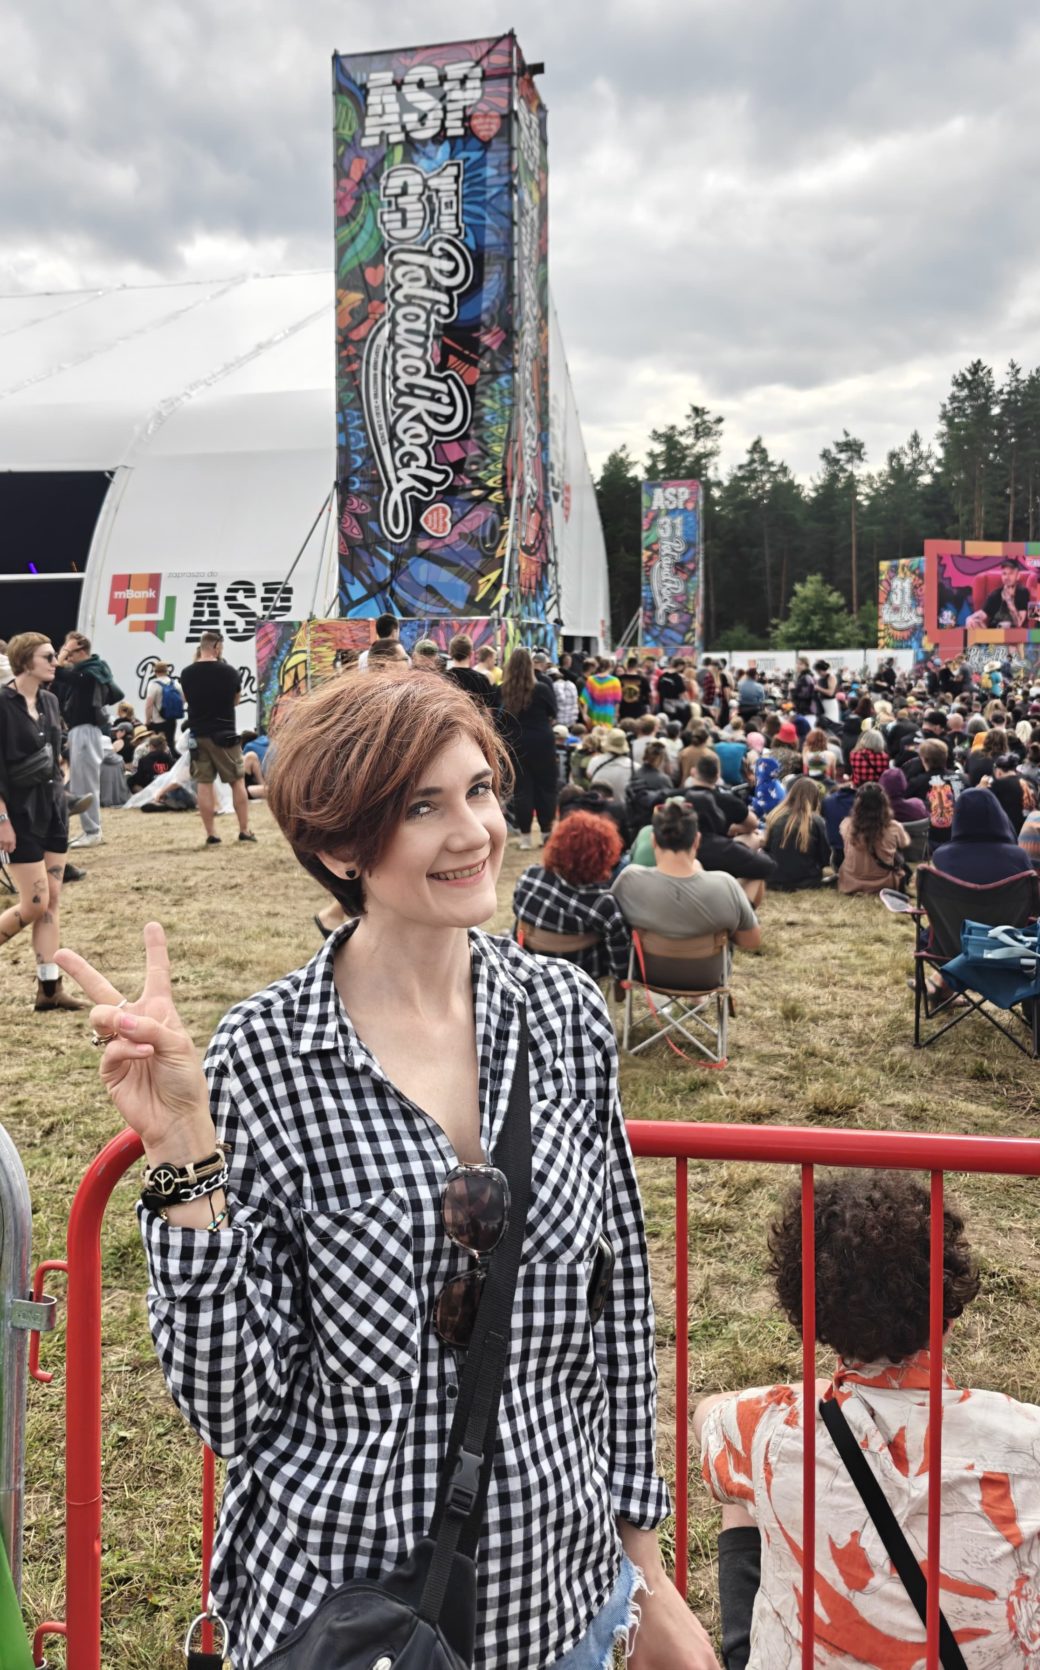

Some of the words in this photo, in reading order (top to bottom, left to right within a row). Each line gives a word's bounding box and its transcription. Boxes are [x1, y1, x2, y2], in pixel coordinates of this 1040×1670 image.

[361, 61, 483, 147] ASP
[381, 163, 462, 243] 31
[651, 487, 690, 510] ASP
[657, 516, 684, 538] 31
[114, 588, 156, 599] mBank
[185, 580, 293, 643] ASP
